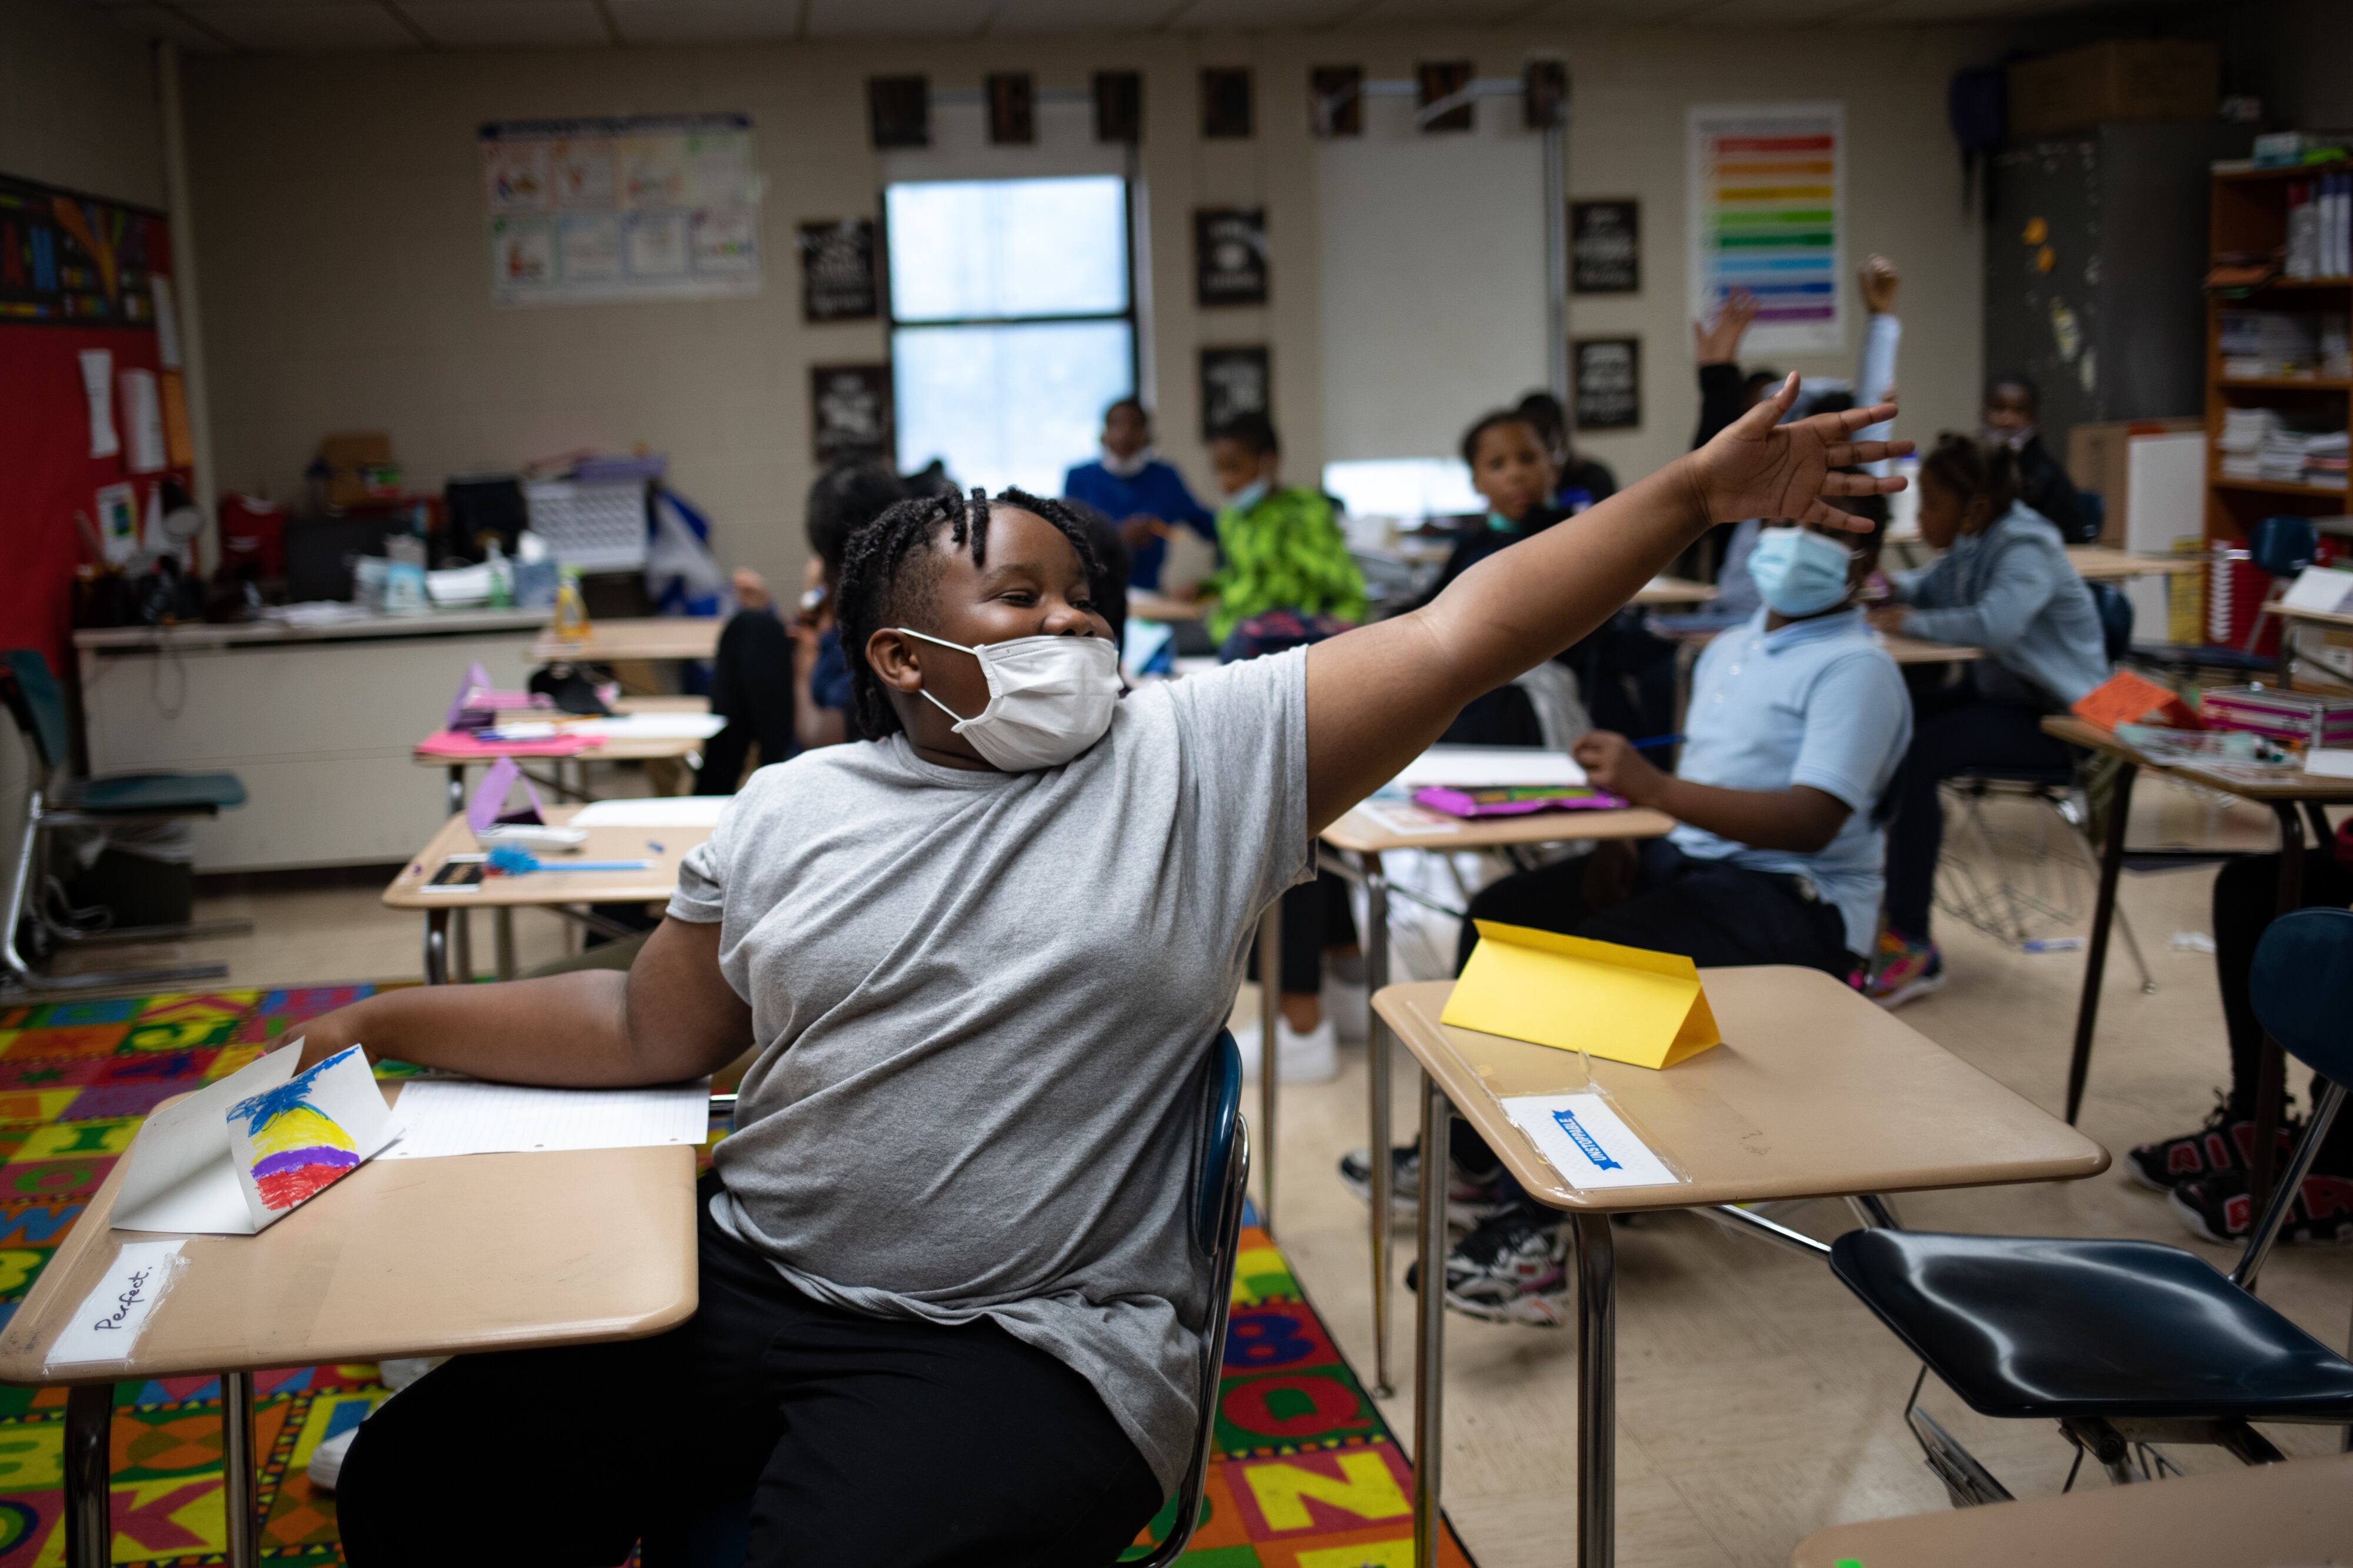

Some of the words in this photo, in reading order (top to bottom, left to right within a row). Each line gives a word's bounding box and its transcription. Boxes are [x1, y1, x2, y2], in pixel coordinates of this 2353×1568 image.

[1558, 1117, 1608, 1162] UNSTOPPABLE
[1222, 1375, 1374, 1437] Q
[1242, 1450, 1412, 1532] N
